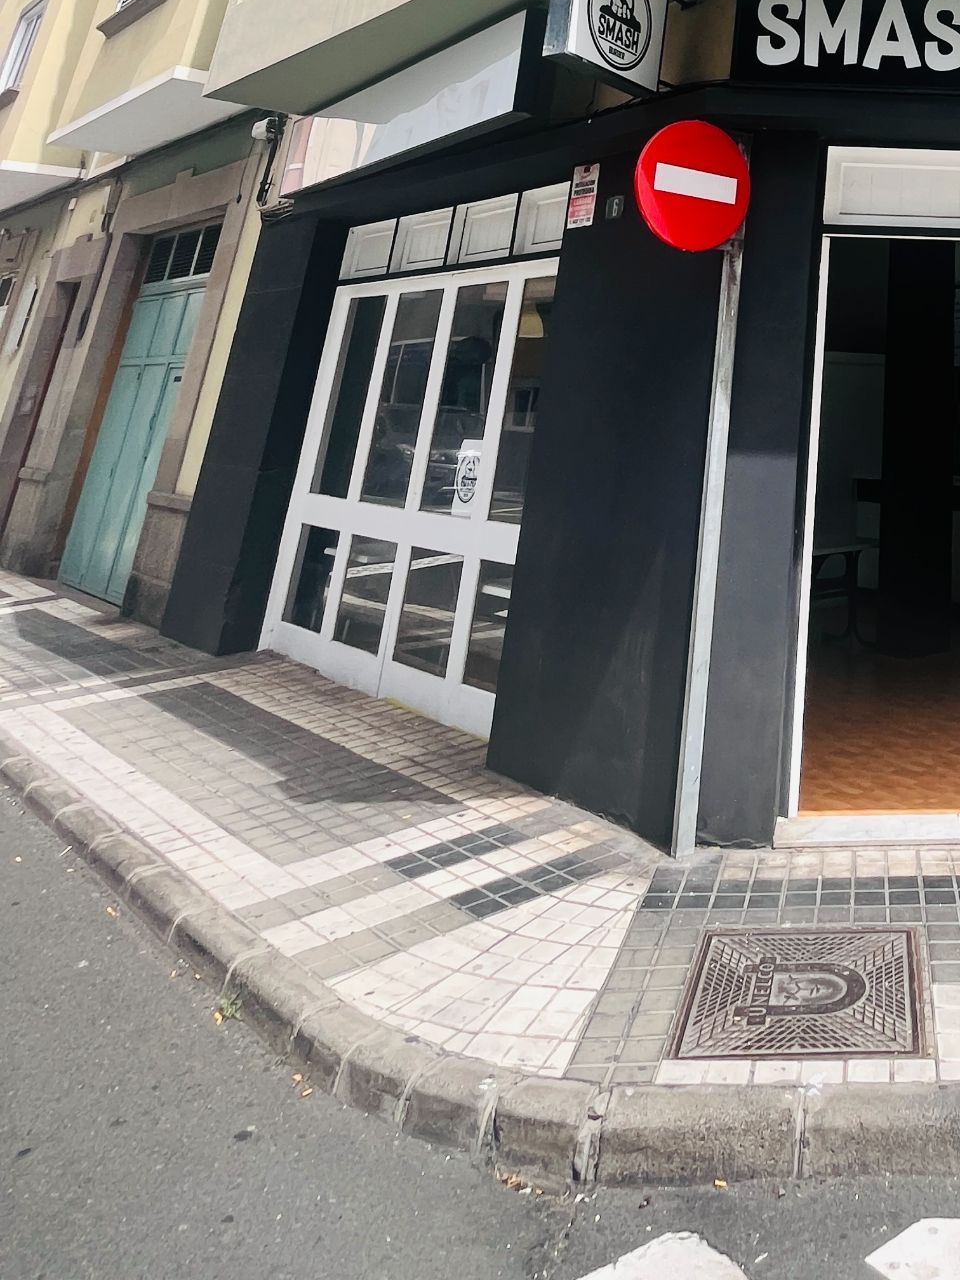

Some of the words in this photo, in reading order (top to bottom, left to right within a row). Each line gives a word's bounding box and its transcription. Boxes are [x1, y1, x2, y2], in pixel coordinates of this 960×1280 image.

[598, 14, 640, 54] SMASH
[612, 198, 620, 217] 6
[749, 962, 775, 1017] UNELCO
